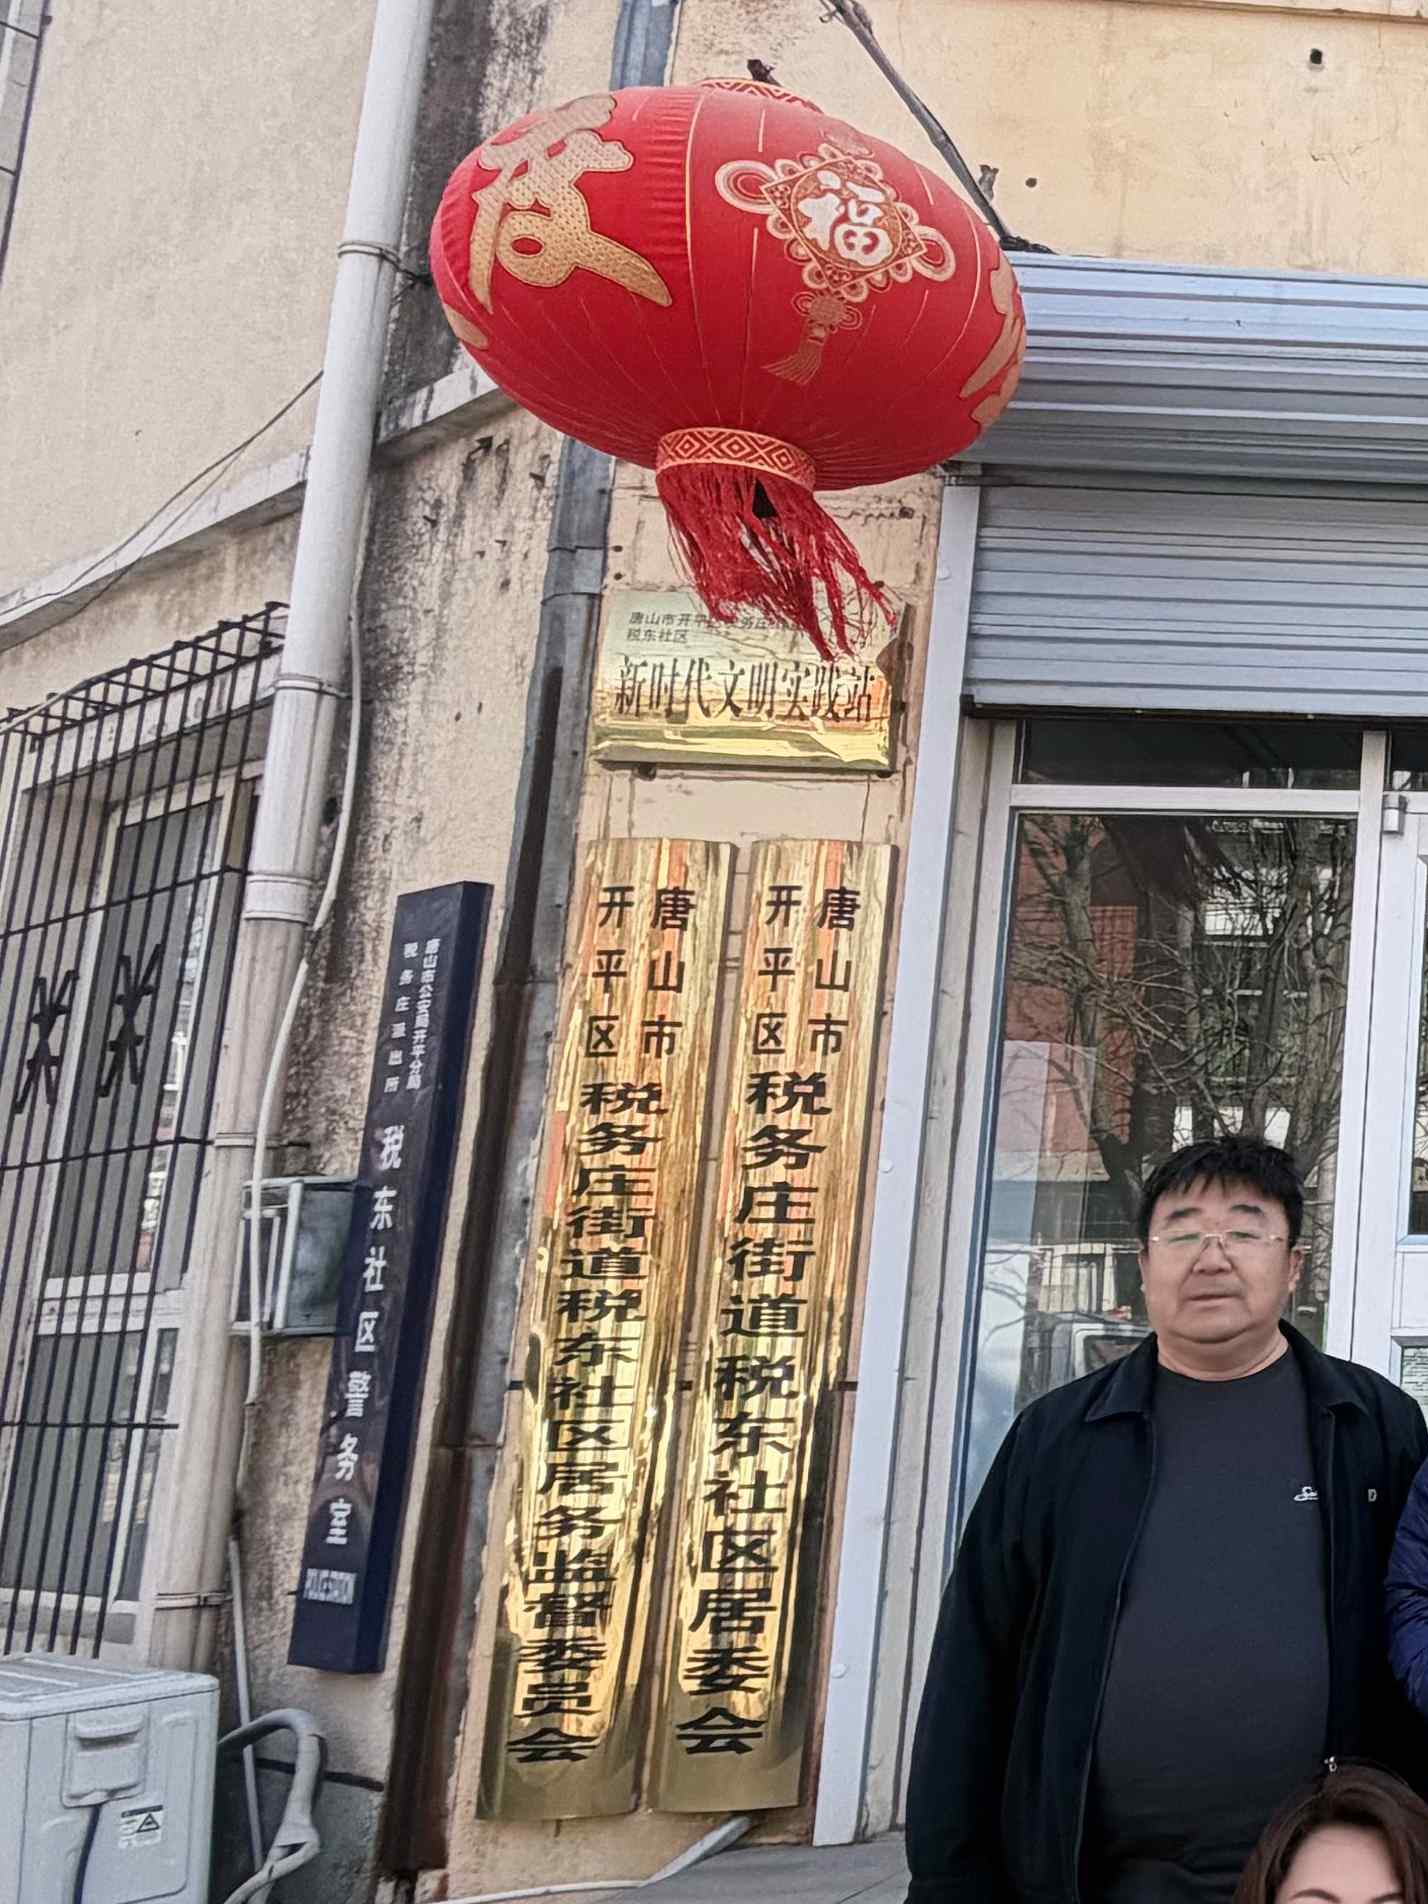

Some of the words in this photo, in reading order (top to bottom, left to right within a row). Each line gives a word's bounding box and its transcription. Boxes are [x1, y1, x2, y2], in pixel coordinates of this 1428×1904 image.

[798, 166, 894, 268] 福
[614, 654, 876, 723] 新时代文明实践站
[627, 627, 689, 644] 税东社区
[585, 884, 635, 1058] 开平区
[641, 885, 697, 1059] 唐山市
[750, 884, 802, 1057] 开平区
[806, 885, 862, 1058] 唐山市
[324, 1124, 406, 1546] 税东社区警务室
[506, 1079, 670, 1764] 税务庄街道税东社区居务监督委员会
[675, 1069, 834, 1755] 税务庄街道税东社区居委会
